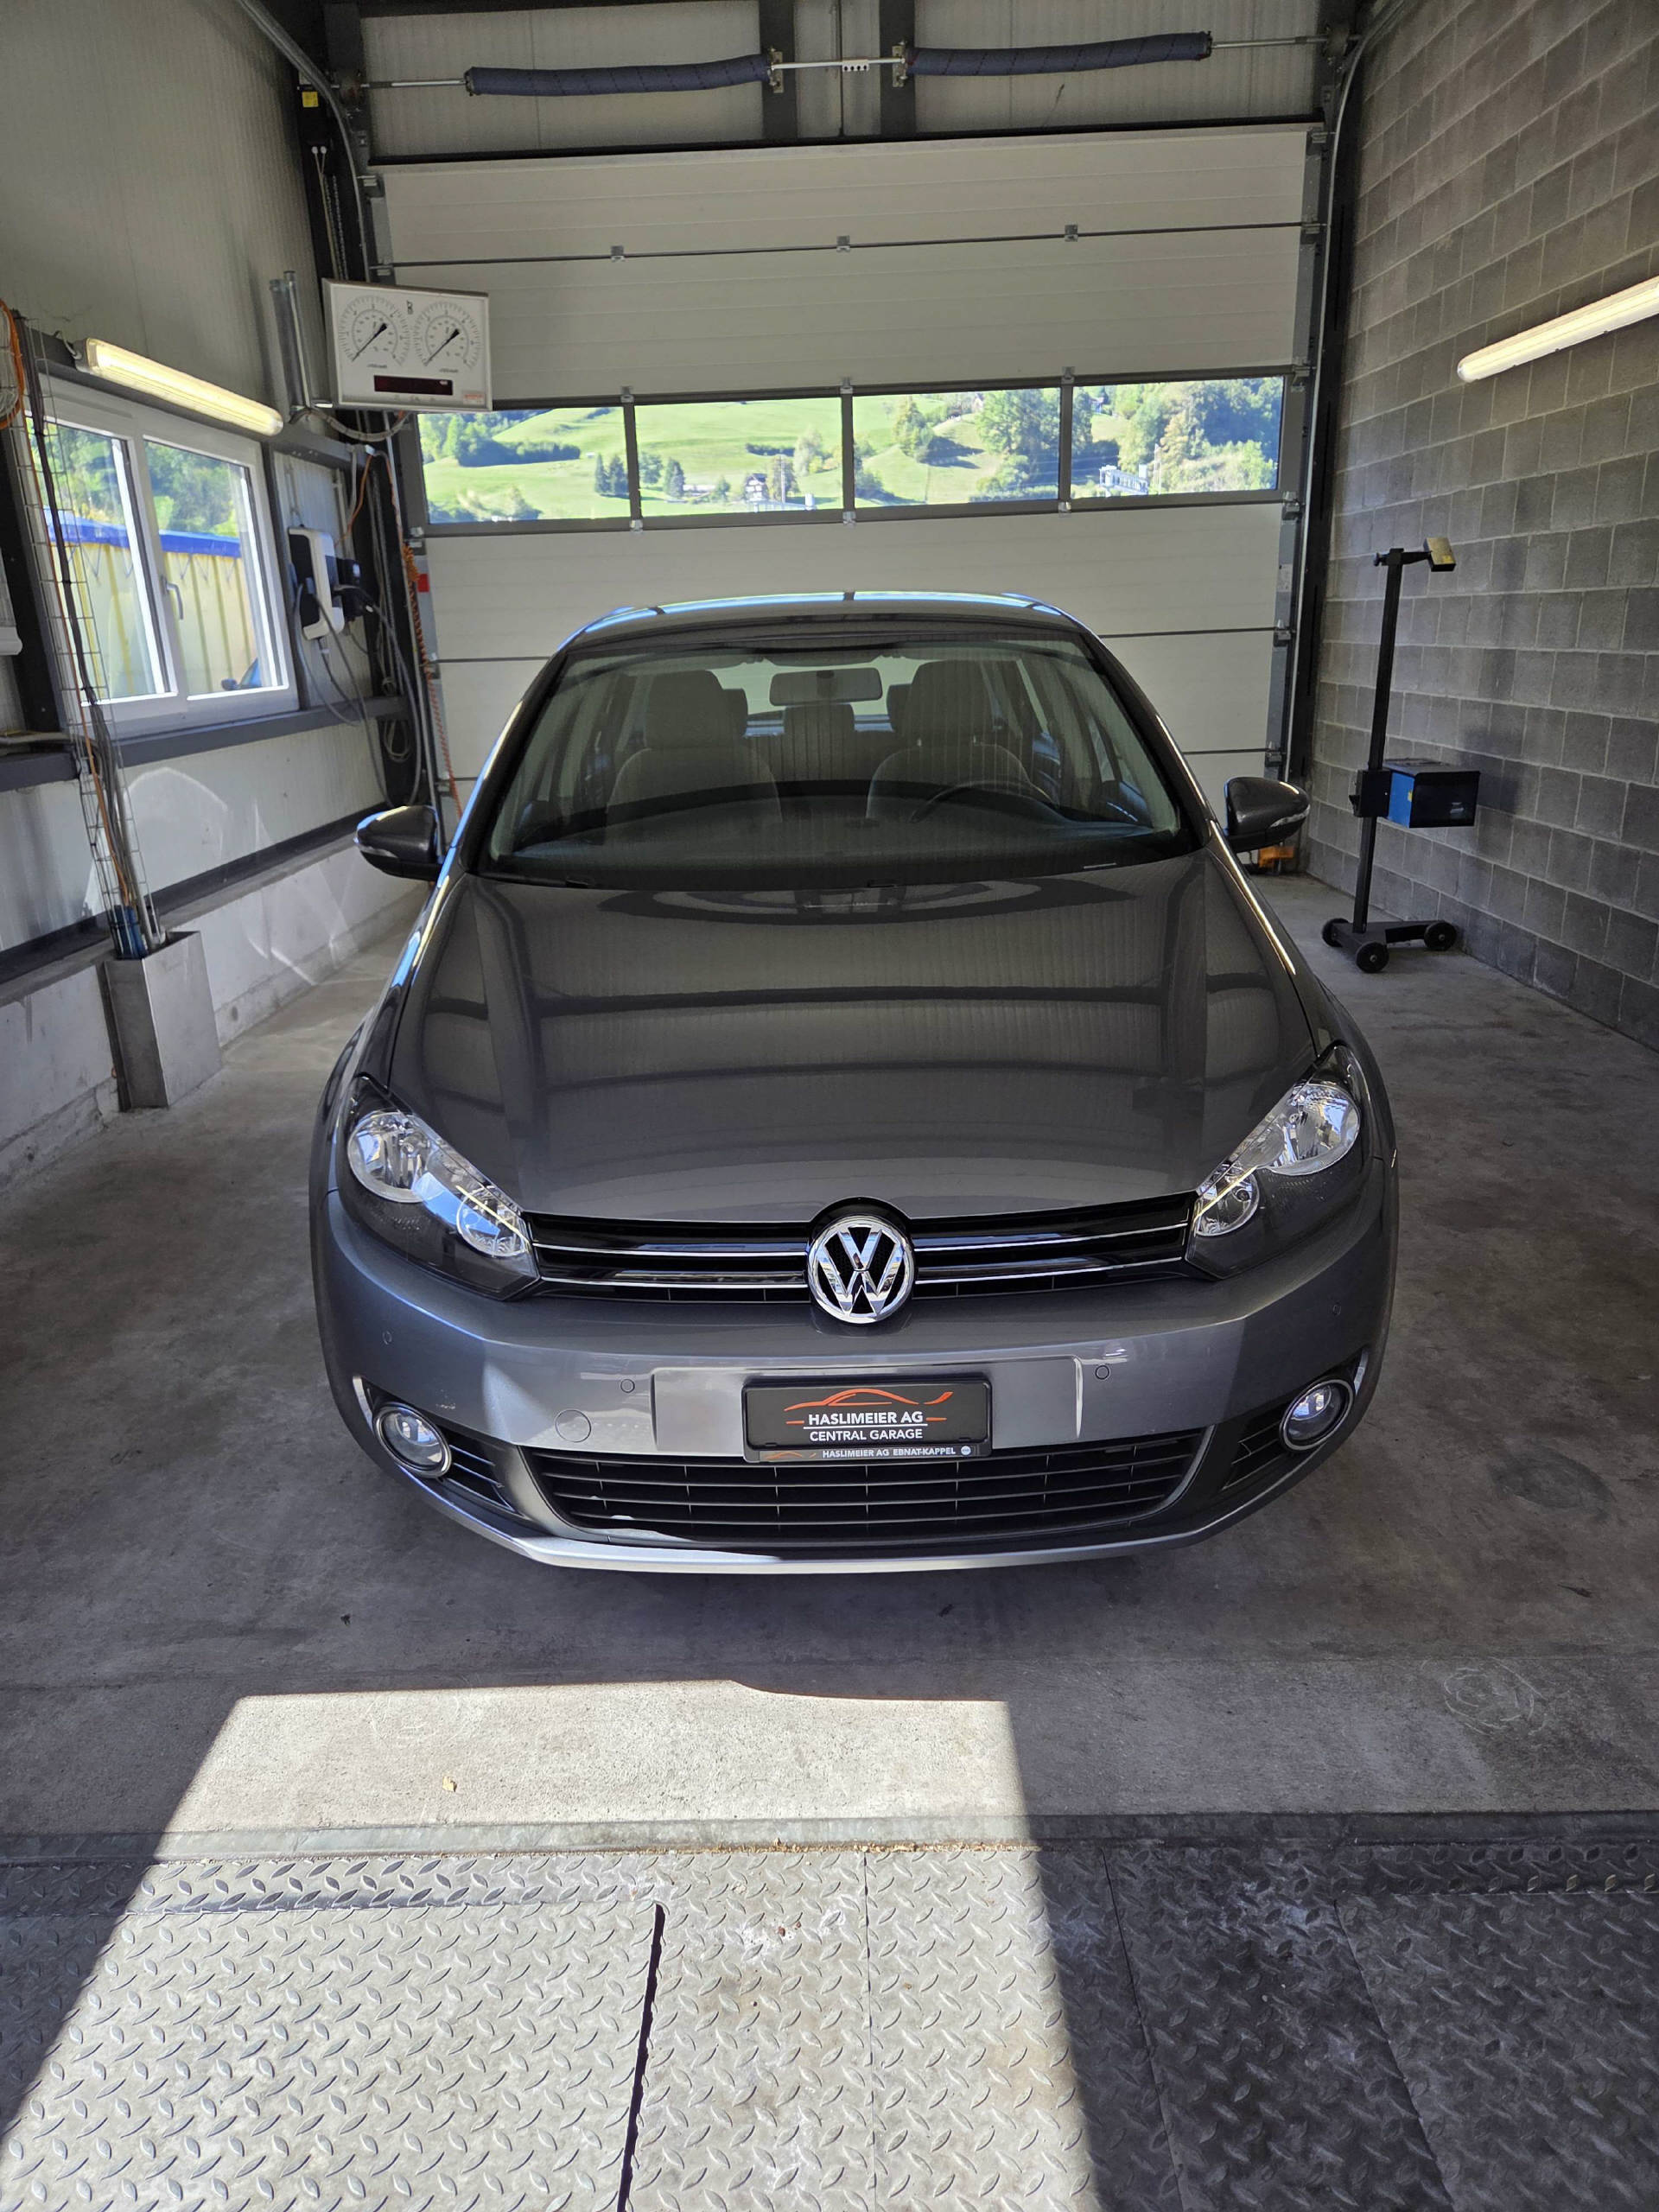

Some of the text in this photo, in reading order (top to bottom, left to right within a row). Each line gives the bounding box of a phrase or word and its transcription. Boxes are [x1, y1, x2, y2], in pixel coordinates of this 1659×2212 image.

[814, 1222, 908, 1319] VW
[808, 1411, 924, 1425] HASLIMEIER AG
[810, 1428, 923, 1442] CENTRAL GARAGE
[823, 1449, 874, 1459] HASLIMEIER
[876, 1448, 890, 1457] AG
[893, 1446, 957, 1457] EBNAT-KAPPEL
